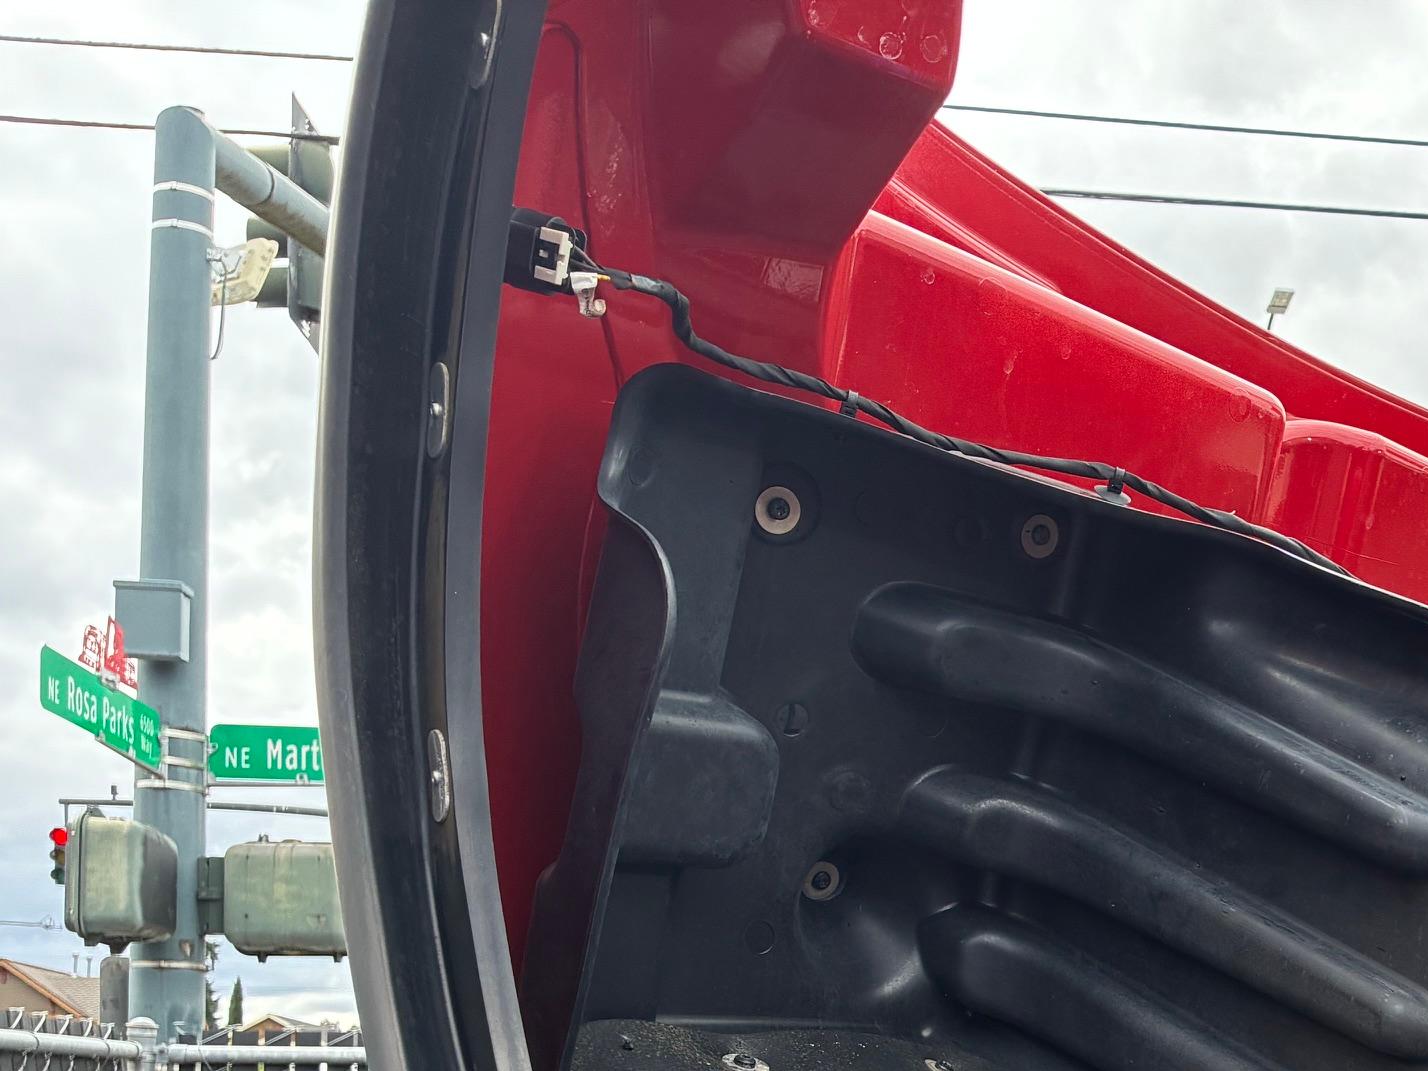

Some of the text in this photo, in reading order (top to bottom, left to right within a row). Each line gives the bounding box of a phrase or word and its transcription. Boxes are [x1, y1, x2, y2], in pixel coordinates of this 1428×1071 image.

[48, 675, 135, 745] NE Rosa Parks
[140, 734, 153, 759] Way
[224, 737, 320, 772] NE Mart
